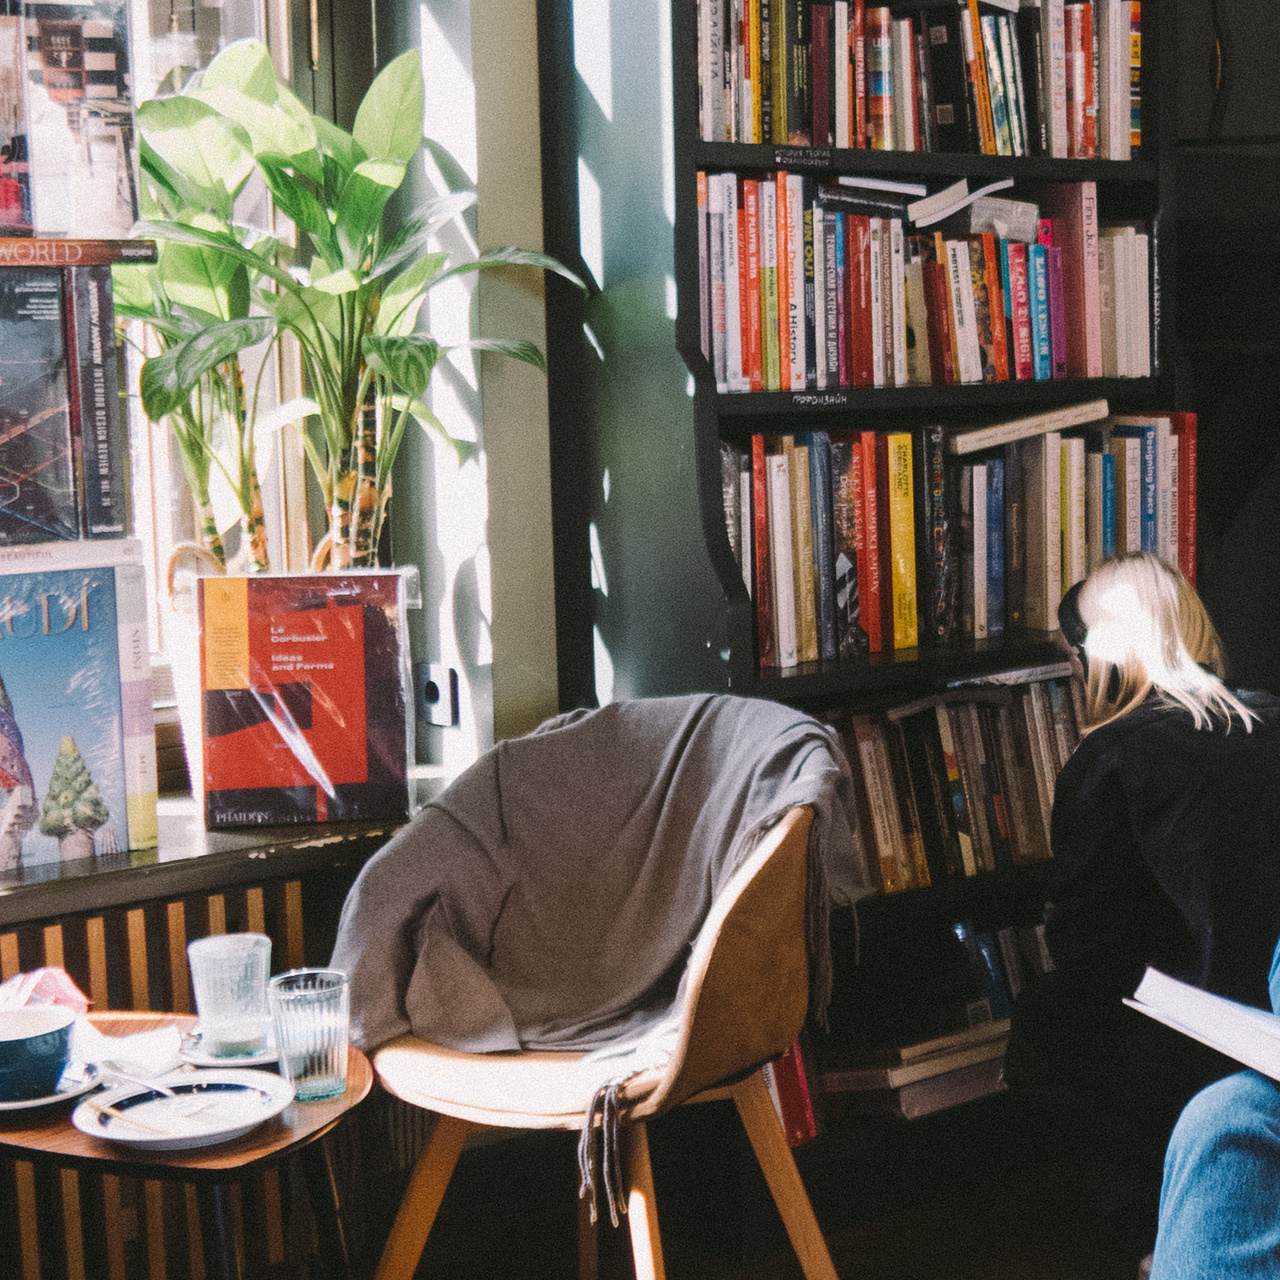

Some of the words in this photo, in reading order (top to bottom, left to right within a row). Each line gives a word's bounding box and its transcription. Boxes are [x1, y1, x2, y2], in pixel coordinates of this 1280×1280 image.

[748, 194, 756, 216] NEW
[1084, 196, 1096, 226] Finn
[748, 217, 757, 254] PLAYFUL
[803, 209, 813, 242] WIN
[749, 256, 757, 279] DATA
[804, 244, 814, 278] OUT
[825, 233, 836, 289] ТЕХНИЧЕСКАЯ
[826, 291, 837, 331] ЭСТЕТИКА
[788, 314, 799, 365] History
[827, 340, 839, 373] ДИЗАЙН
[93, 367, 106, 408] INTERIOR
[95, 409, 107, 441] DESIGN
[97, 443, 109, 475] REVIEW
[1145, 430, 1156, 483] Designing
[852, 455, 862, 492] NICKY
[1147, 484, 1156, 514] Peace
[854, 499, 863, 551] HASLAM
[270, 626, 285, 634] Le
[270, 634, 328, 643] Corbusier
[271, 654, 303, 662] Ideas
[272, 663, 294, 672] and
[296, 662, 335, 671] Forms
